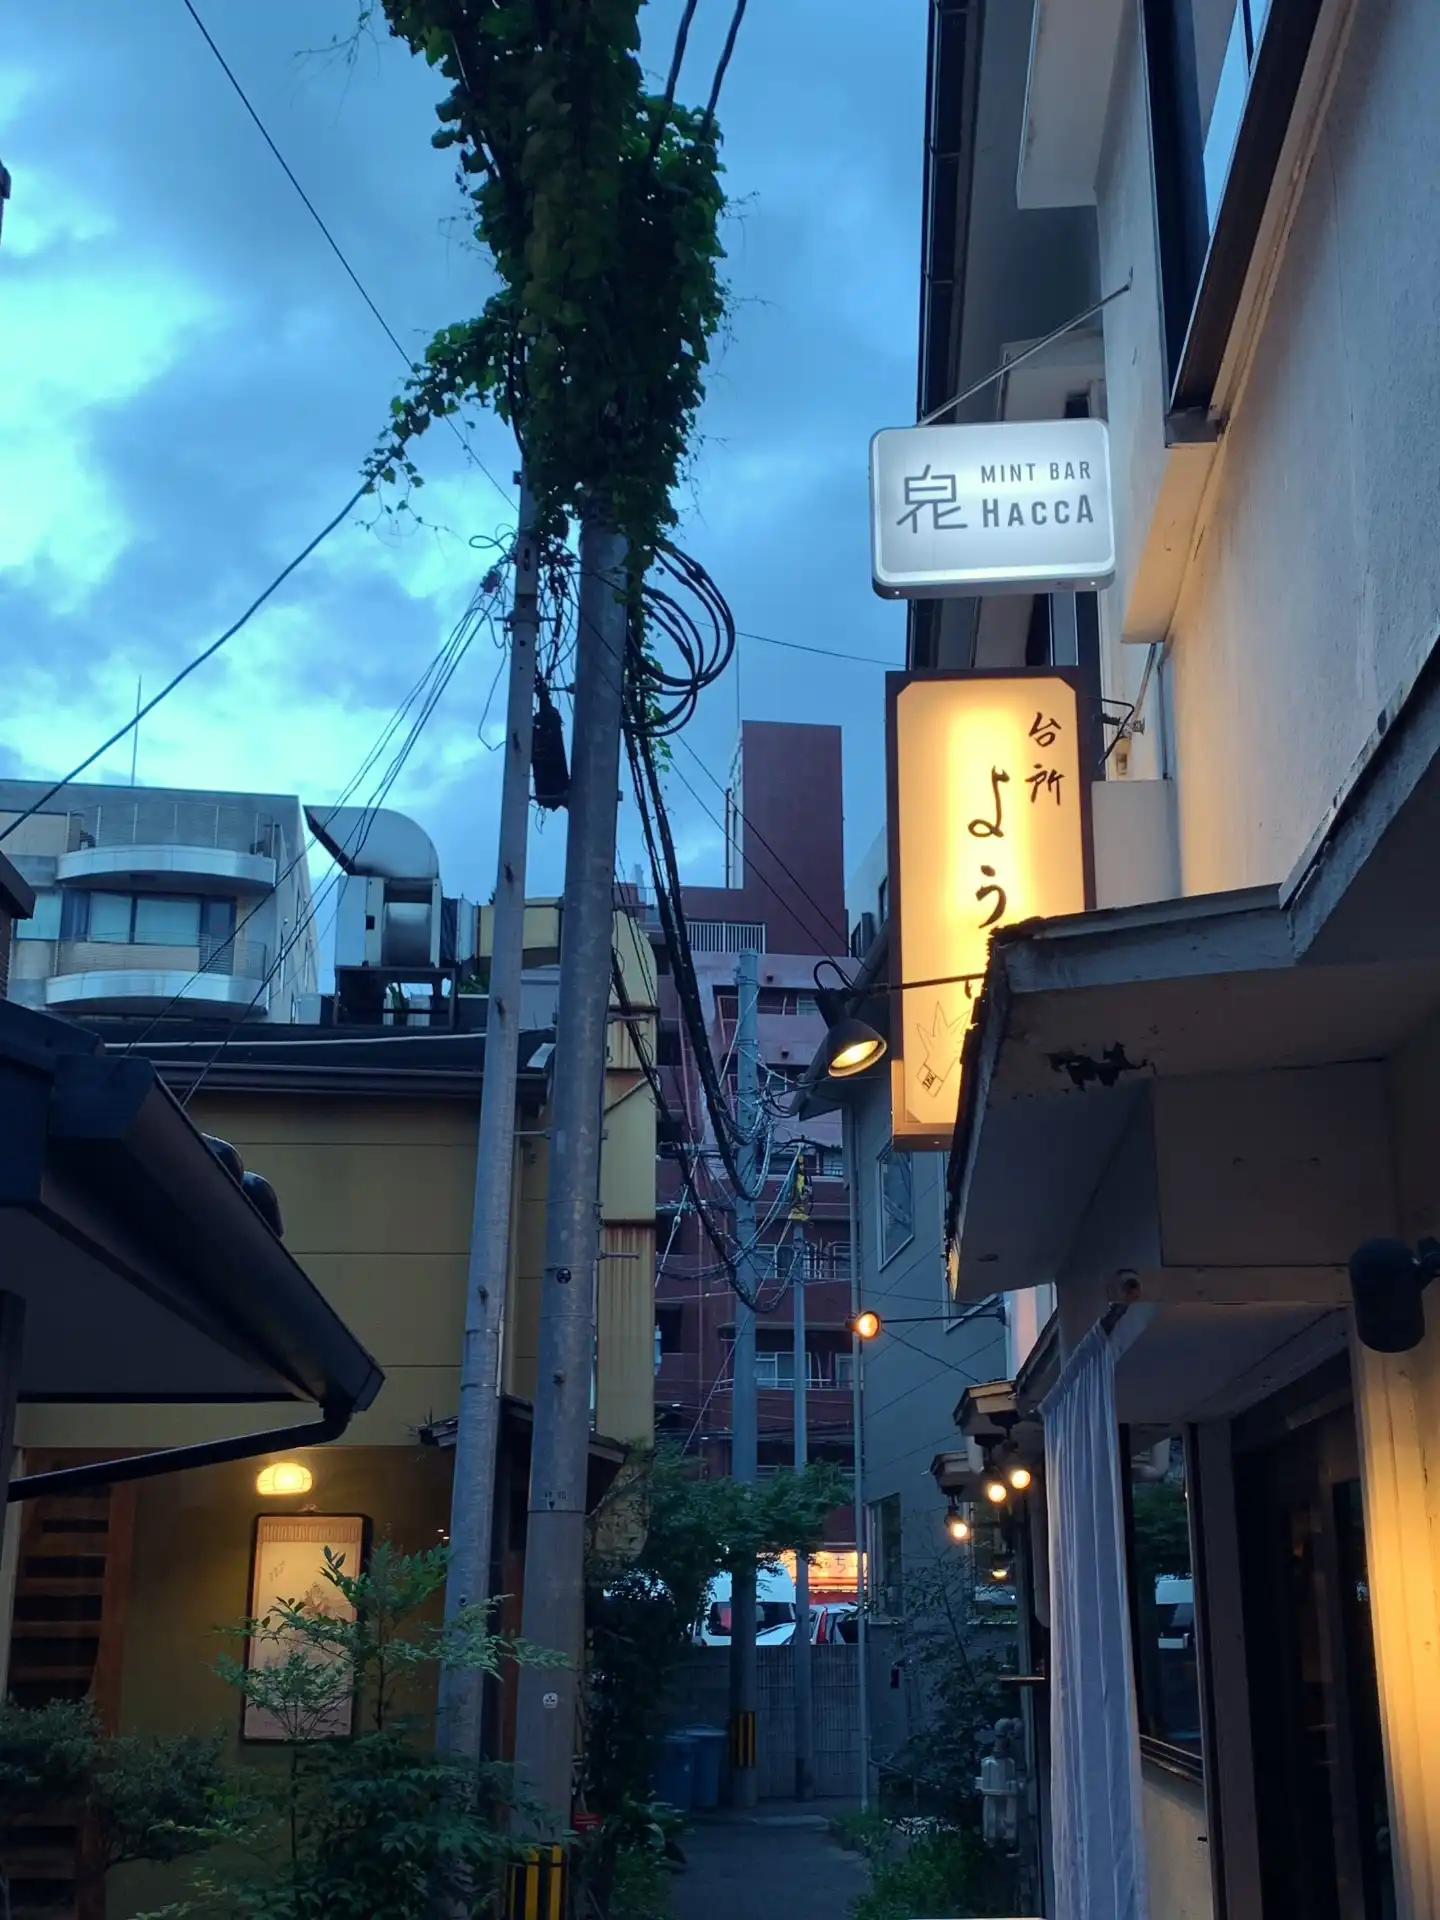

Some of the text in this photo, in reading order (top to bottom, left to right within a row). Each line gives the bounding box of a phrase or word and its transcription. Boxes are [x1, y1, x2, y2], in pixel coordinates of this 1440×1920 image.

[981, 461, 1091, 483] MINT BAR
[982, 494, 1094, 528] HACCA
[1025, 711, 1065, 806] 台所
